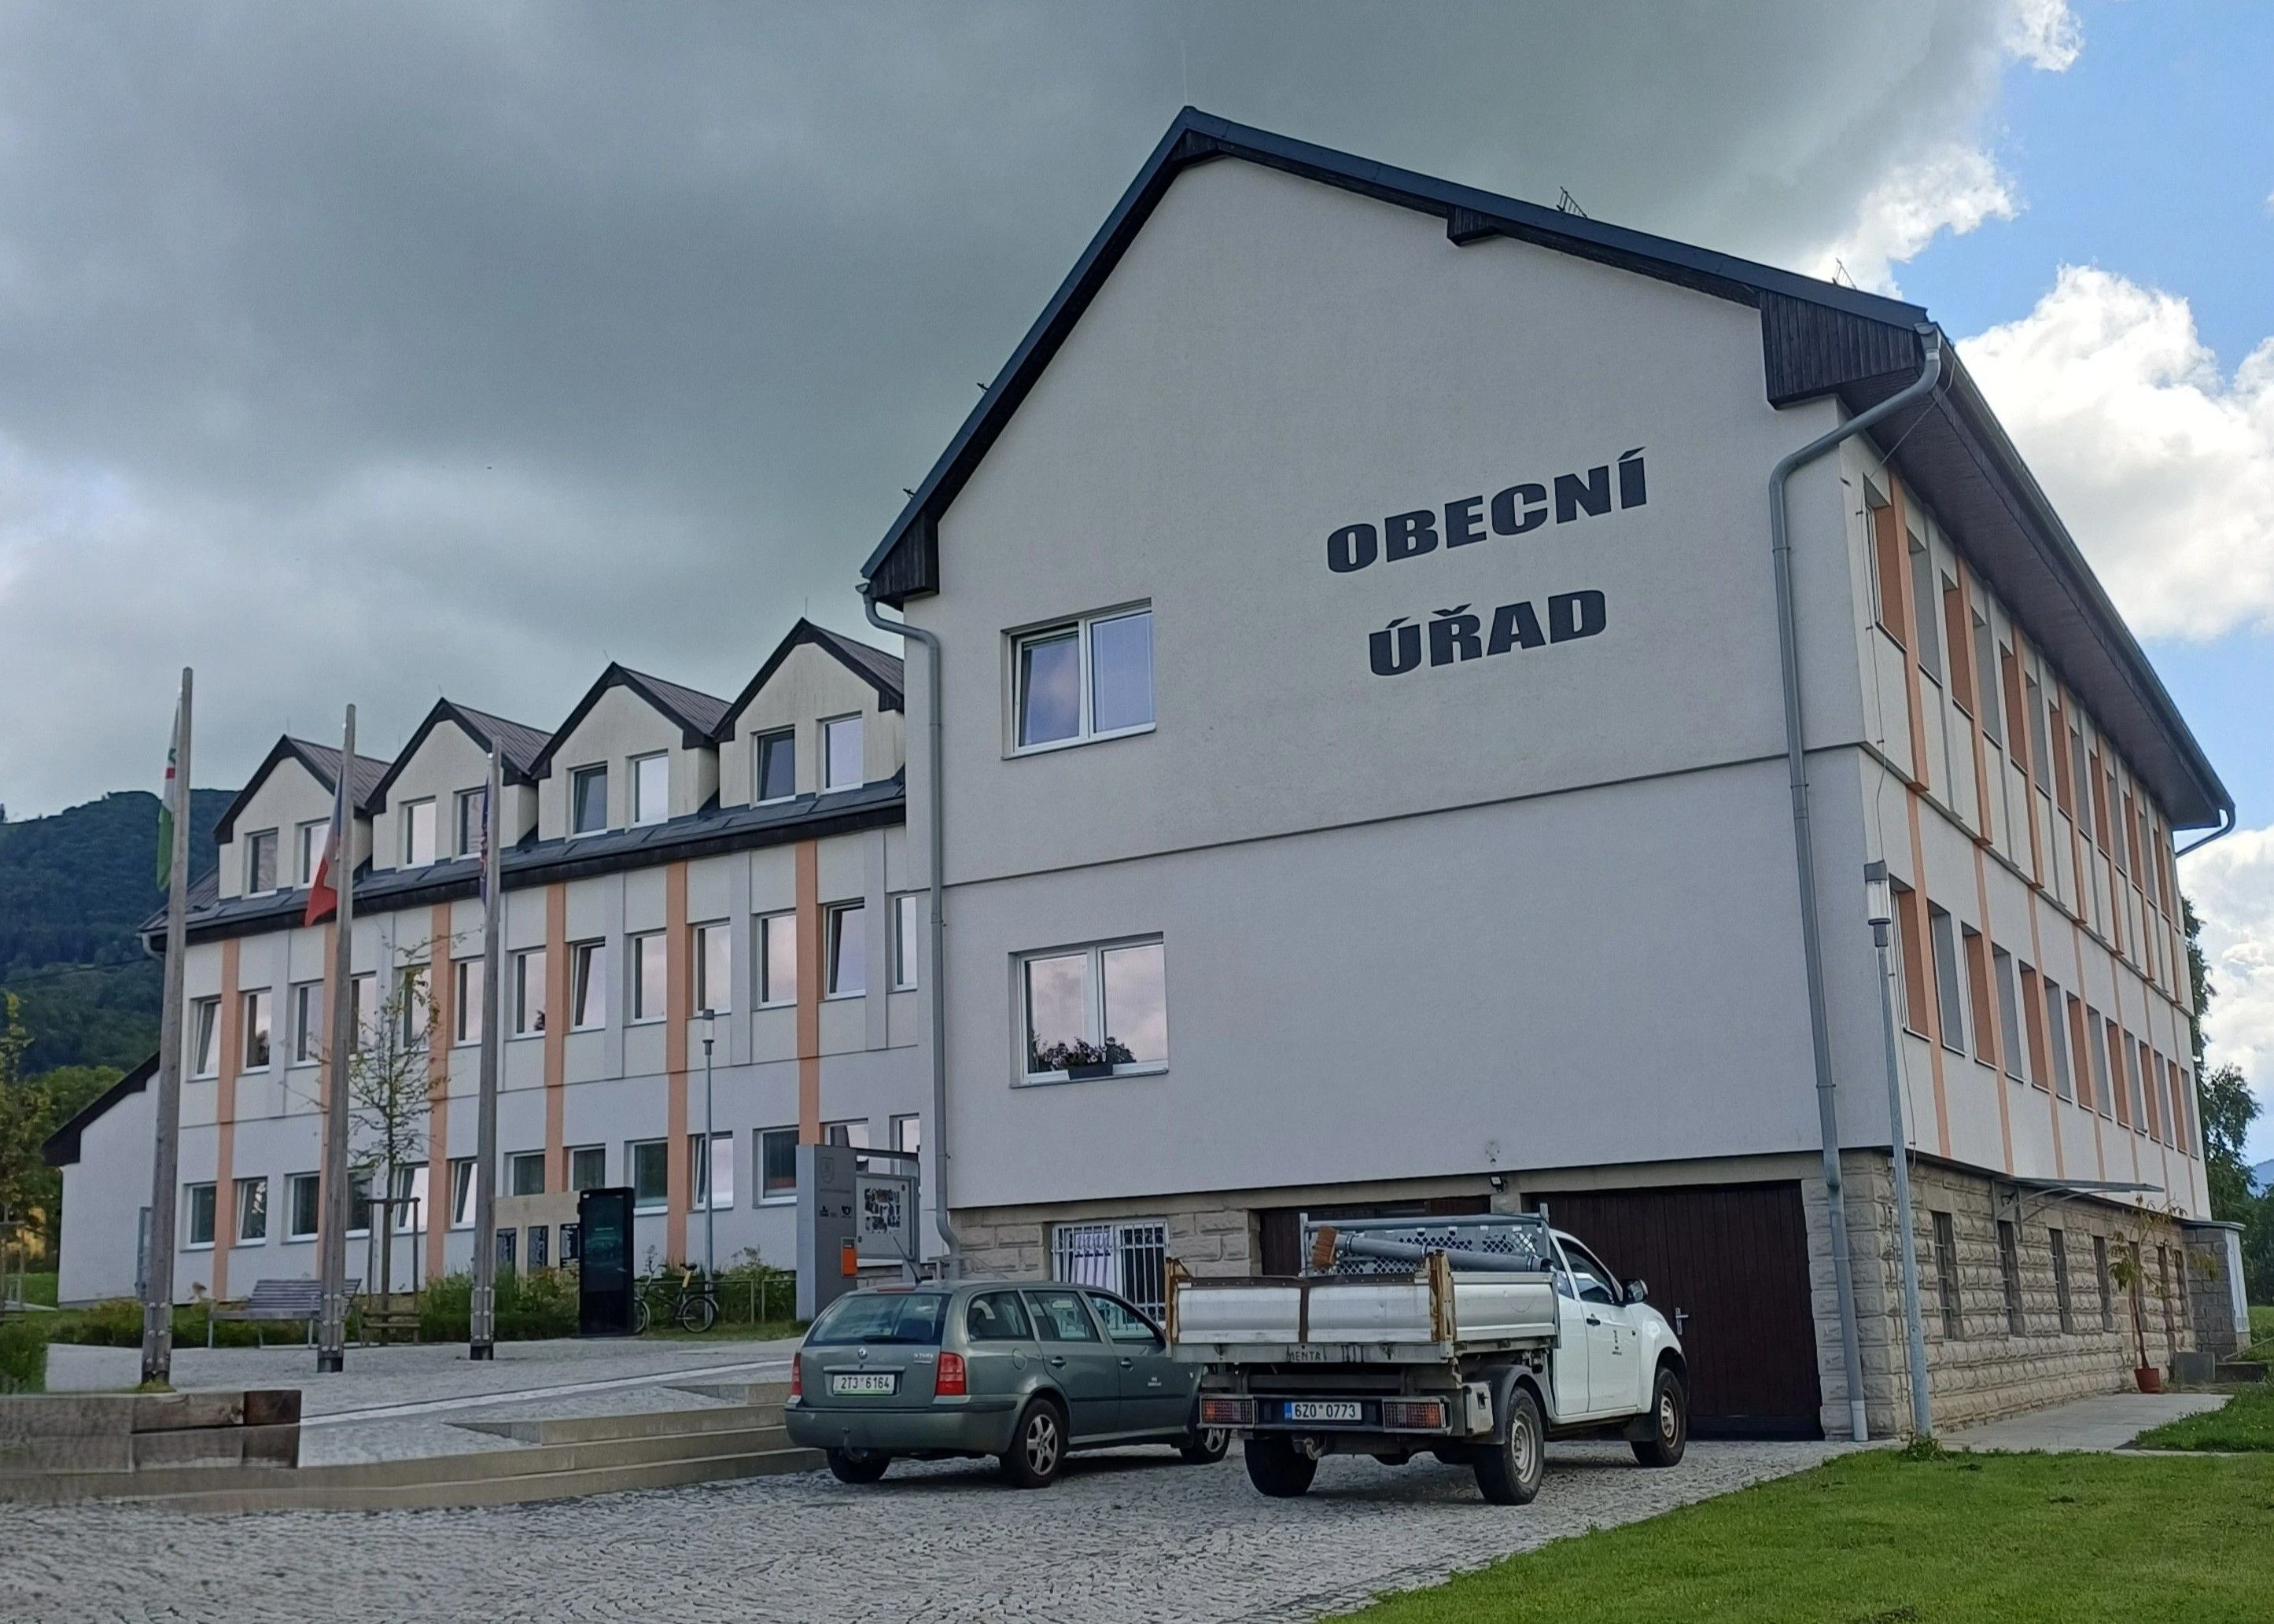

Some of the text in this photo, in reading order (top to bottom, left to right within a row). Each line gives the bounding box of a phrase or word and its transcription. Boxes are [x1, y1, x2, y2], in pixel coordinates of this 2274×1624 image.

[1327, 446, 1646, 573] OBECNÍ
[1369, 590, 1606, 676] ÚŘAD
[841, 1377, 890, 1389] 2T3 6164
[1295, 1404, 1355, 1417] 6Z0 0773
